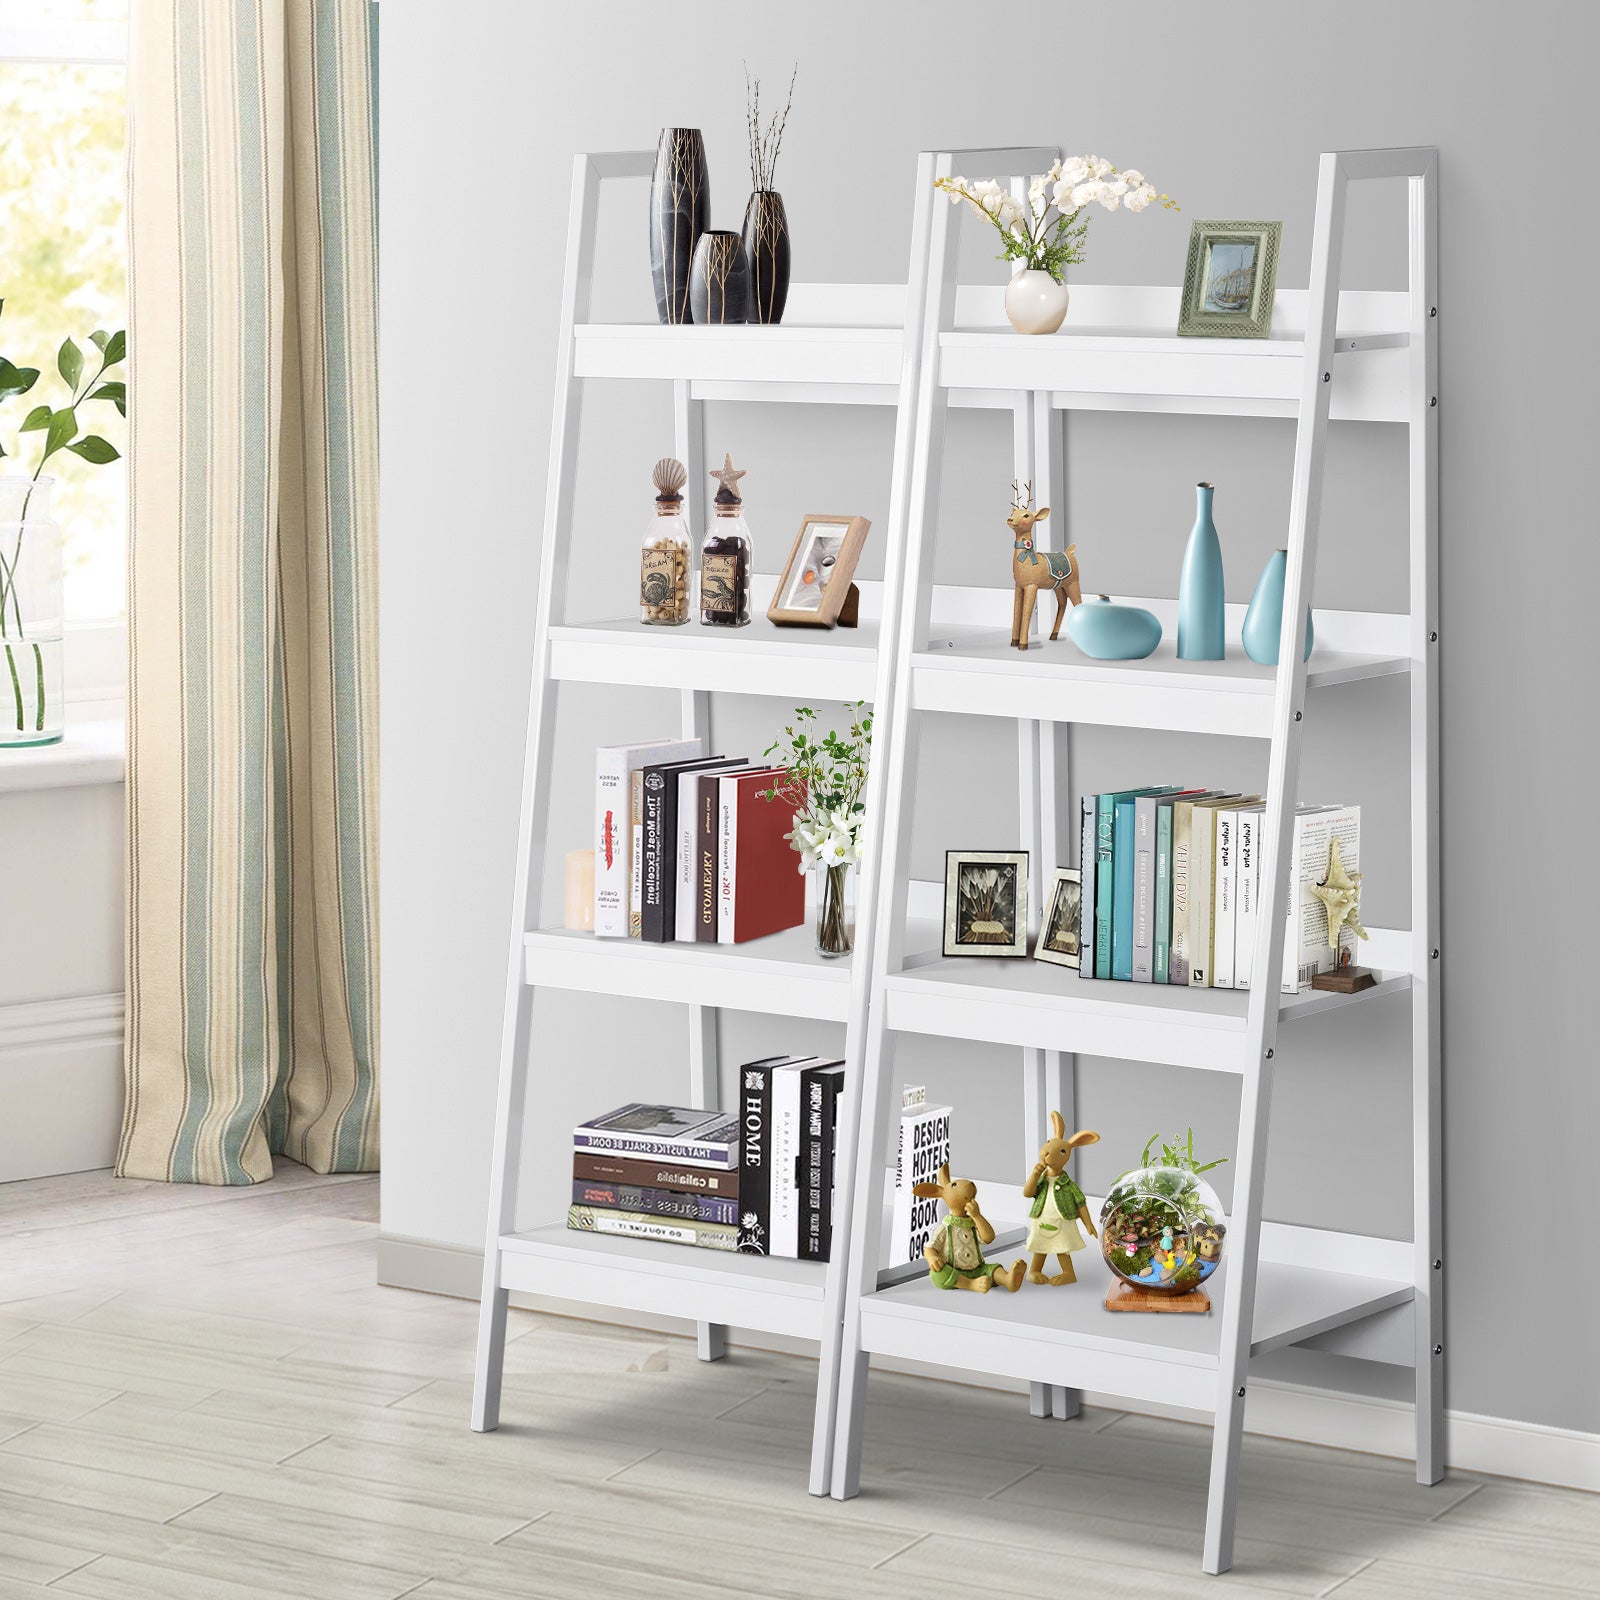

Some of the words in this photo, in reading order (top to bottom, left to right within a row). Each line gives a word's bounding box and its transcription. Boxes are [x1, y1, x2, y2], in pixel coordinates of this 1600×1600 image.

[644, 559, 668, 570] DREAM
[746, 1096, 762, 1167] HOME
[913, 1116, 950, 1150] DESIGN
[912, 1143, 950, 1178] HOTELS
[910, 1199, 938, 1232] BOOK
